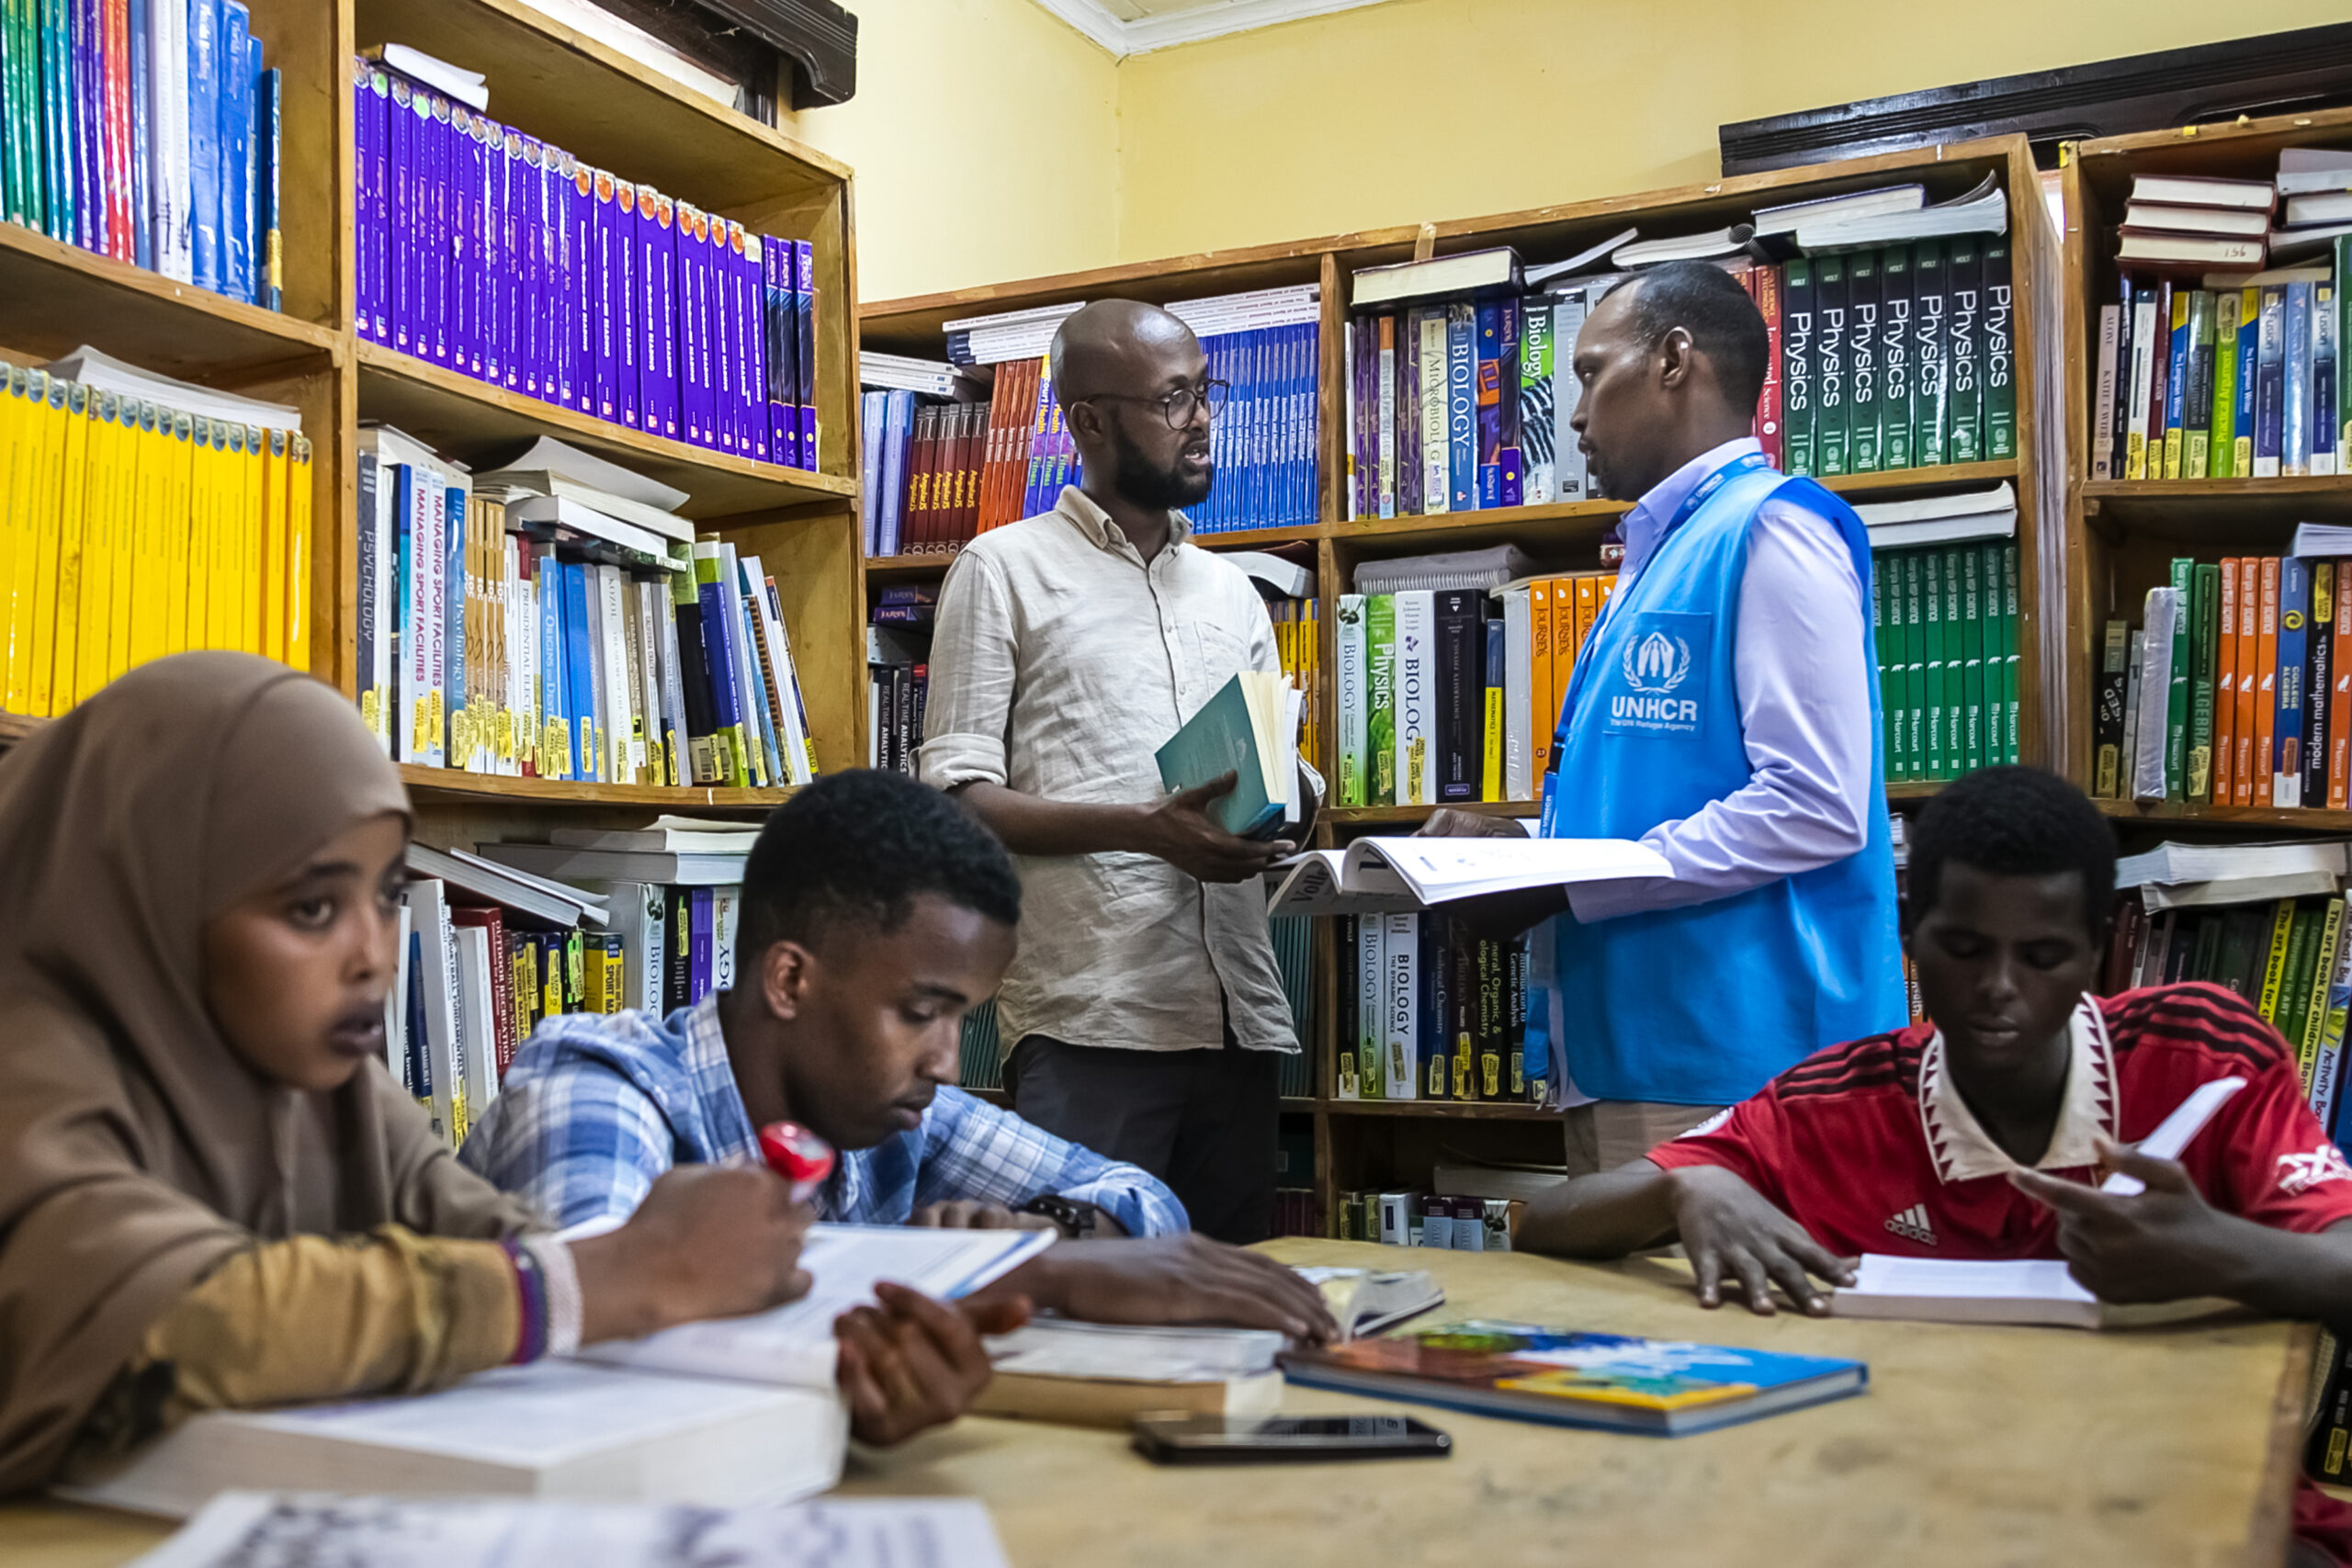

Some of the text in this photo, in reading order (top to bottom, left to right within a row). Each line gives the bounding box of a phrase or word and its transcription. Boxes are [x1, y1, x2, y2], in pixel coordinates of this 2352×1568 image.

[1522, 315, 1548, 381] Biology
[1916, 295, 1943, 396] Physics
[1950, 290, 1977, 391] Physics
[1984, 285, 2012, 388] Physics
[2264, 312, 2277, 350] Fusion
[2317, 308, 2330, 345] Fusion
[1785, 312, 1812, 411] Physics
[1818, 308, 1845, 407] Physics
[1850, 303, 1877, 403] Physics
[1883, 299, 1909, 400] Physics
[1452, 343, 1470, 447] BIOLOGY
[2216, 349, 2232, 444] Practical Argument
[1037, 405, 1048, 434] Health
[919, 472, 930, 511] AngularJS
[933, 472, 943, 510] AngularJS
[942, 471, 953, 509] AngularJS
[955, 469, 965, 508] AngularJS
[967, 469, 978, 508] AngularJS
[1030, 456, 1041, 487] Fitness
[1044, 456, 1056, 486] Fitness
[1057, 454, 1069, 484] Fitness
[910, 473, 920, 512] AngularJS
[362, 530, 374, 641] PSYCHOLOGY
[415, 488, 425, 682] MANAGING SPORT FACILITIES
[433, 495, 443, 687] MANAGING SPORT FACILITIES
[609, 578, 617, 621] KOZOL
[454, 603, 465, 681] Psychology
[545, 615, 556, 668] ORIGINS
[2243, 607, 2254, 636] SCIENCE
[2263, 605, 2274, 635] SCIENCE
[1344, 644, 1356, 711] BIOLOGY
[1374, 643, 1396, 710] Physics
[2281, 666, 2290, 710] ALGEBRA
[2291, 666, 2300, 710] COLLEGE
[1405, 658, 1420, 746] BIOLOG
[1611, 696, 1697, 721] UNHCR
[2195, 681, 2211, 746] ALGEBRA
[2308, 644, 2325, 769] modern mathematics
[881, 685, 890, 770] REAL-TIME ANALYTIC
[899, 682, 910, 773] REAL-TIME ANALYTICS
[1664, 722, 1695, 732] Agency
[1894, 719, 1903, 753] Harcourt
[1911, 718, 1920, 752] Harcourt
[1930, 716, 1939, 750] Harcourt
[1950, 716, 1959, 750] Harcourt
[1968, 715, 1977, 750] Harcourt
[806, 744, 817, 769] USED
[1543, 795, 1552, 828] UNHCR
[605, 964, 615, 995] SPORT
[1364, 932, 1377, 1004] BIOLOGY
[1491, 942, 1500, 974] neral,
[2265, 908, 2290, 1008] The art book for
[495, 919, 510, 1064] OUTDOOR RECREATION
[650, 946, 661, 1018] BIOLOG
[1396, 953, 1409, 1035] BIOLOGY
[1477, 940, 1488, 1038] ological Chemistry
[1490, 976, 1501, 1022] Organic,
[1510, 953, 1519, 1027] Genetic Analysis
[2304, 909, 2340, 1058] The art book for children
[1436, 990, 1446, 1034] Chemistry
[2281, 997, 2290, 1016] ART
[2296, 997, 2305, 1016] ART
[2318, 966, 2350, 1097] Big Activity
[1884, 1220, 1938, 1246] adidas
